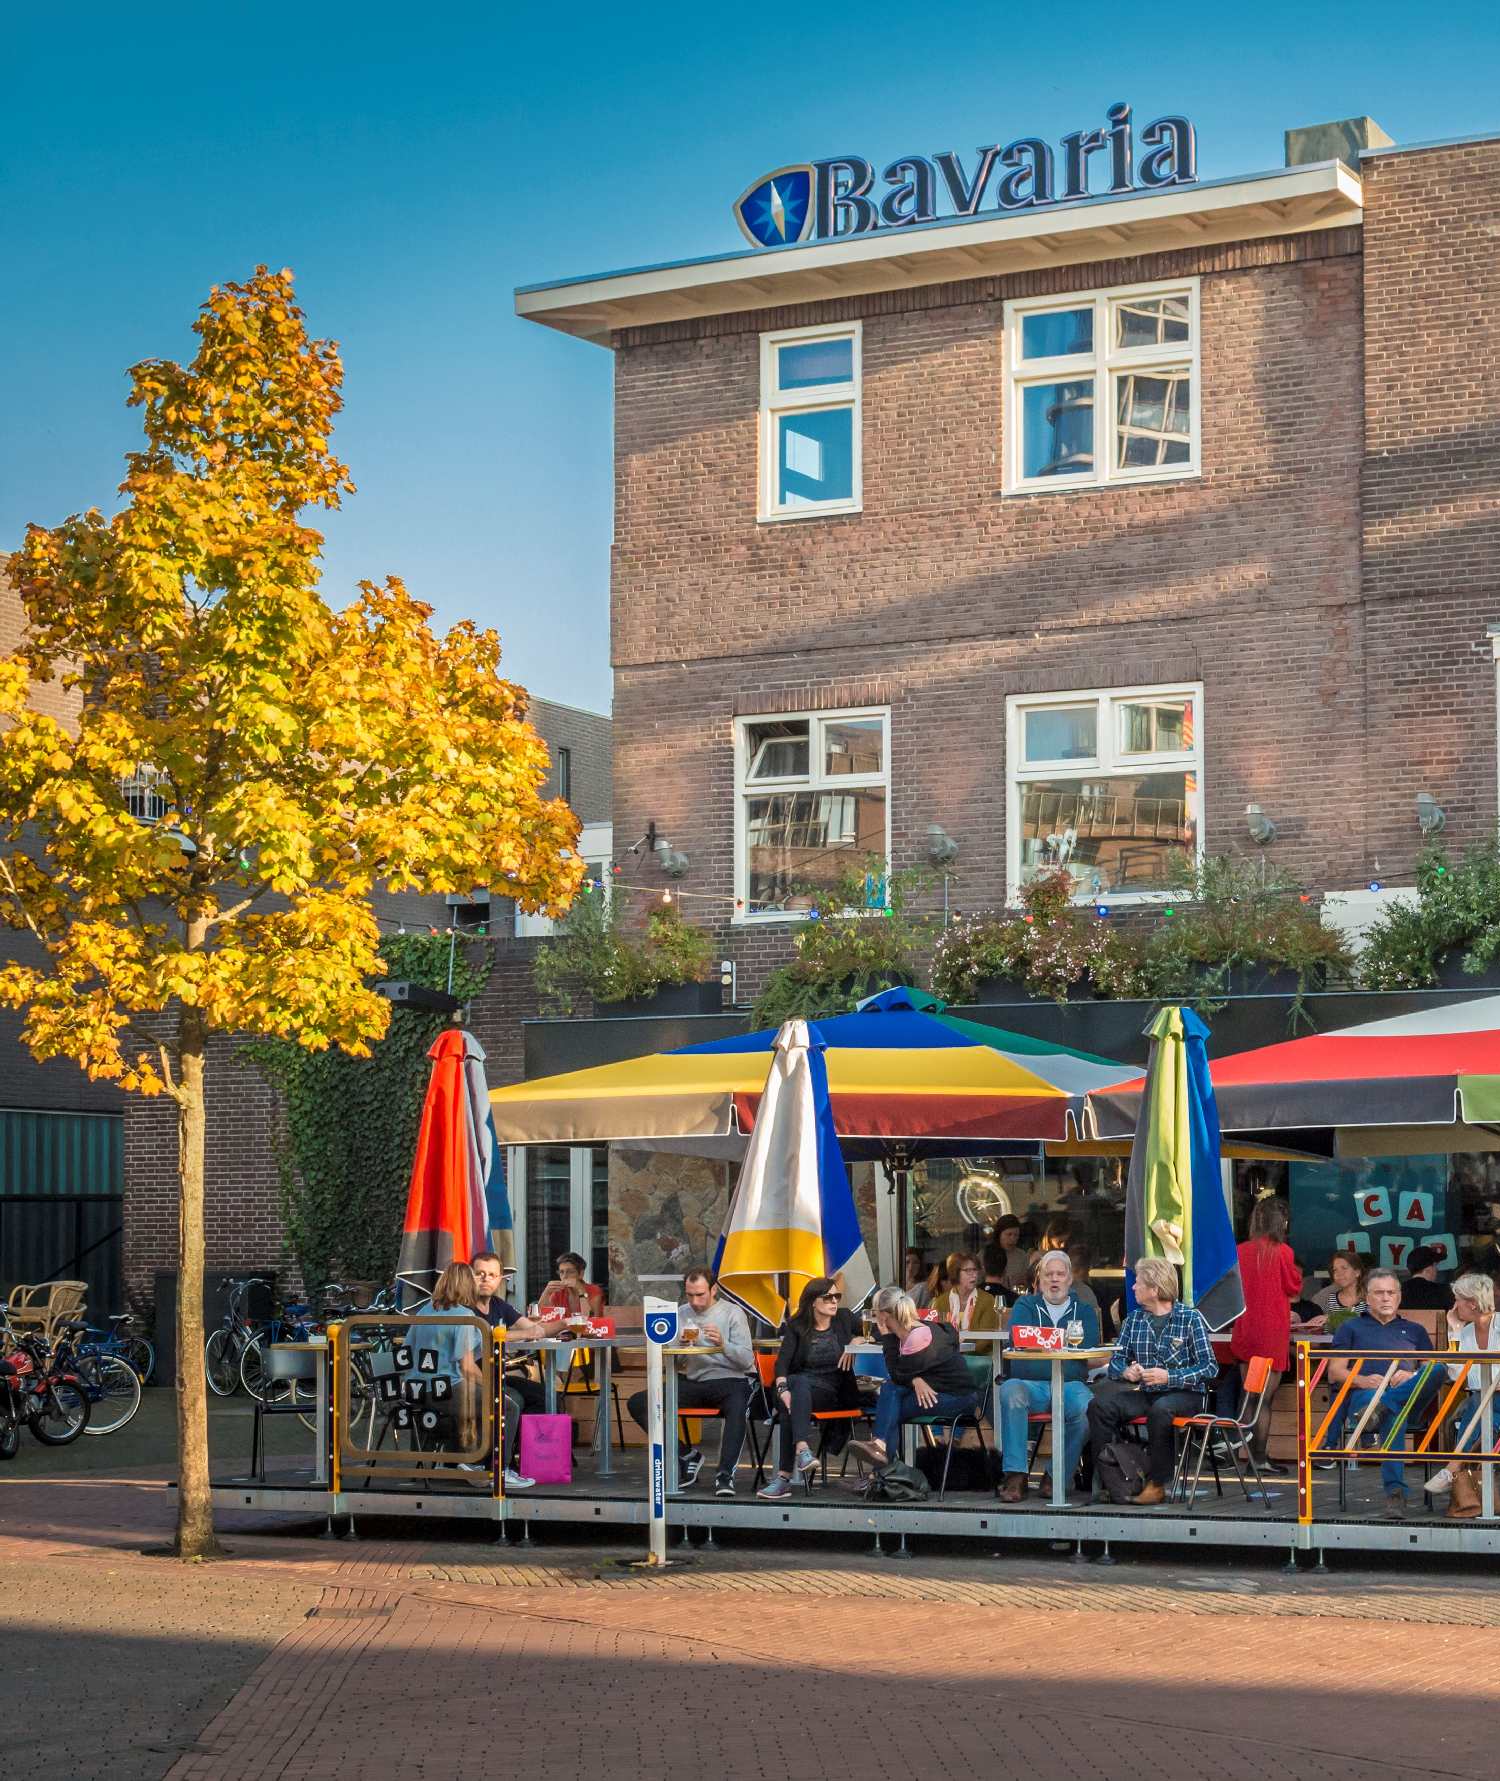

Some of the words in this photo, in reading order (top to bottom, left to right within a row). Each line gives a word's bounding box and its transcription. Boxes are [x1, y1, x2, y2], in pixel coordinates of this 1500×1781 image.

[811, 102, 1199, 240] Bavaria
[1363, 1194, 1426, 1222] CA
[396, 1349, 435, 1370] CA
[385, 1380, 447, 1399] LYP
[398, 1408, 437, 1428] SO
[654, 1458, 662, 1505] drinkwater
